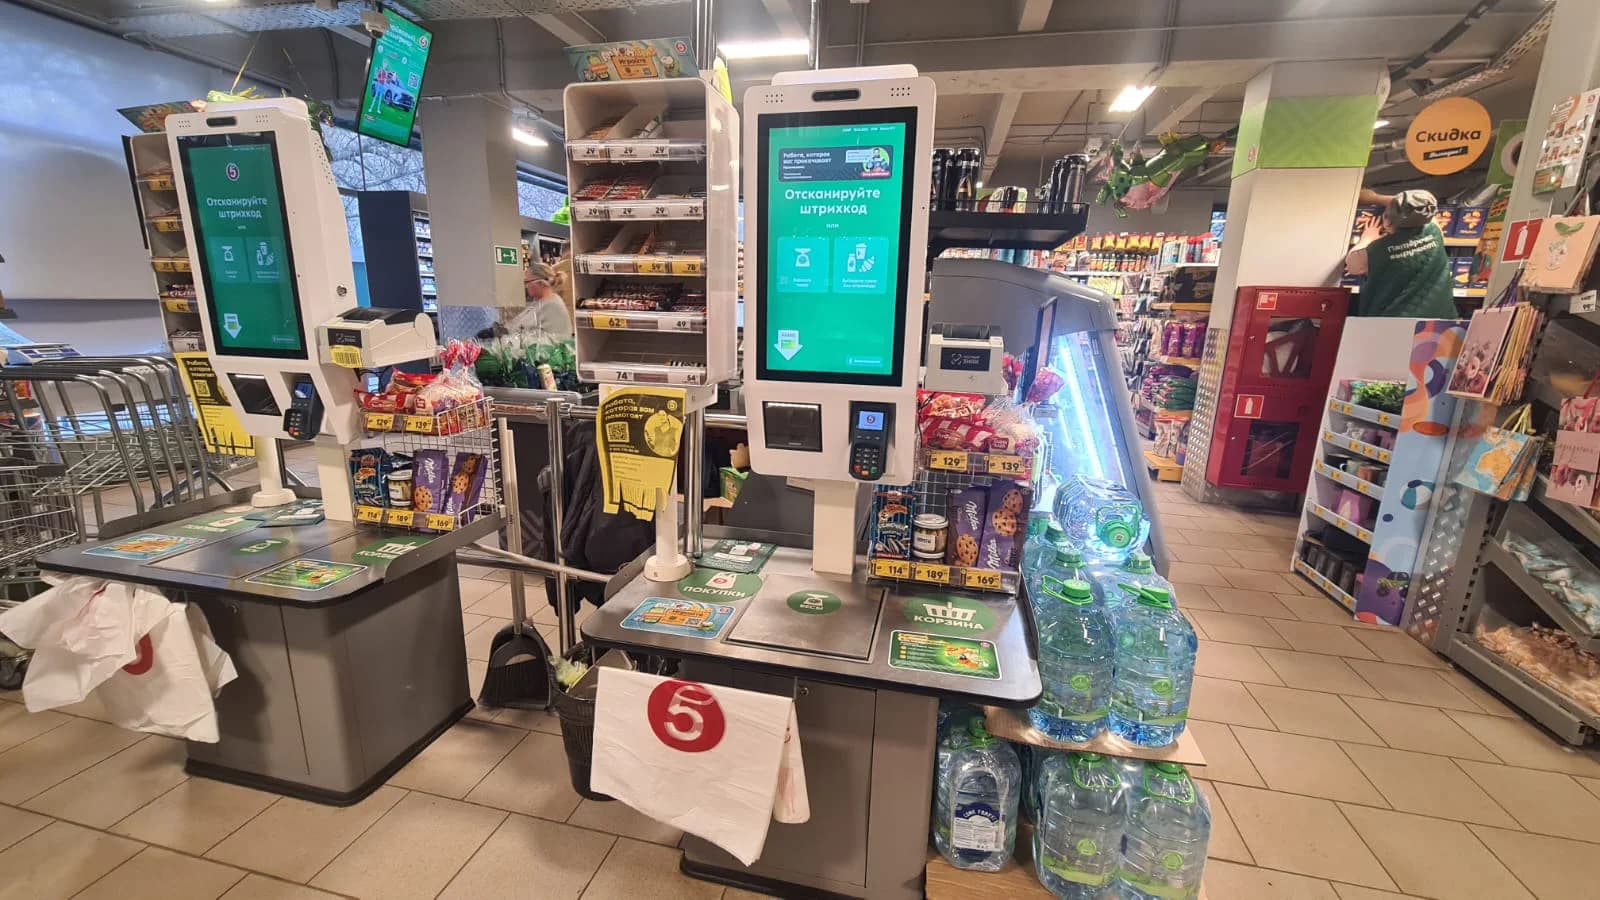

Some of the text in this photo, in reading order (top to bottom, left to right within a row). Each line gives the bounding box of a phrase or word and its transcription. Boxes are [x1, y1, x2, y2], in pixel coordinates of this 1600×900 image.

[1416, 128, 1481, 143] Скидка
[785, 187, 881, 202] Отсканируйте
[206, 196, 268, 208] Отсканируйте
[219, 208, 262, 220] штрихкод
[800, 204, 867, 216] штрихкод
[608, 318, 621, 327] 62
[616, 371, 628, 379] 74
[375, 418, 388, 427] 129
[415, 421, 427, 429] 139
[943, 457, 960, 466] 129
[1002, 461, 1020, 471] 139
[964, 500, 980, 532] Milka
[436, 519, 449, 527] 169
[986, 539, 1001, 569] Milka
[888, 566, 903, 575] 114
[927, 570, 943, 579] 189
[977, 575, 993, 585] 169
[683, 586, 746, 598] ПОКУПКИ
[913, 615, 985, 630] КОРЗИНА
[663, 685, 715, 742] 5
